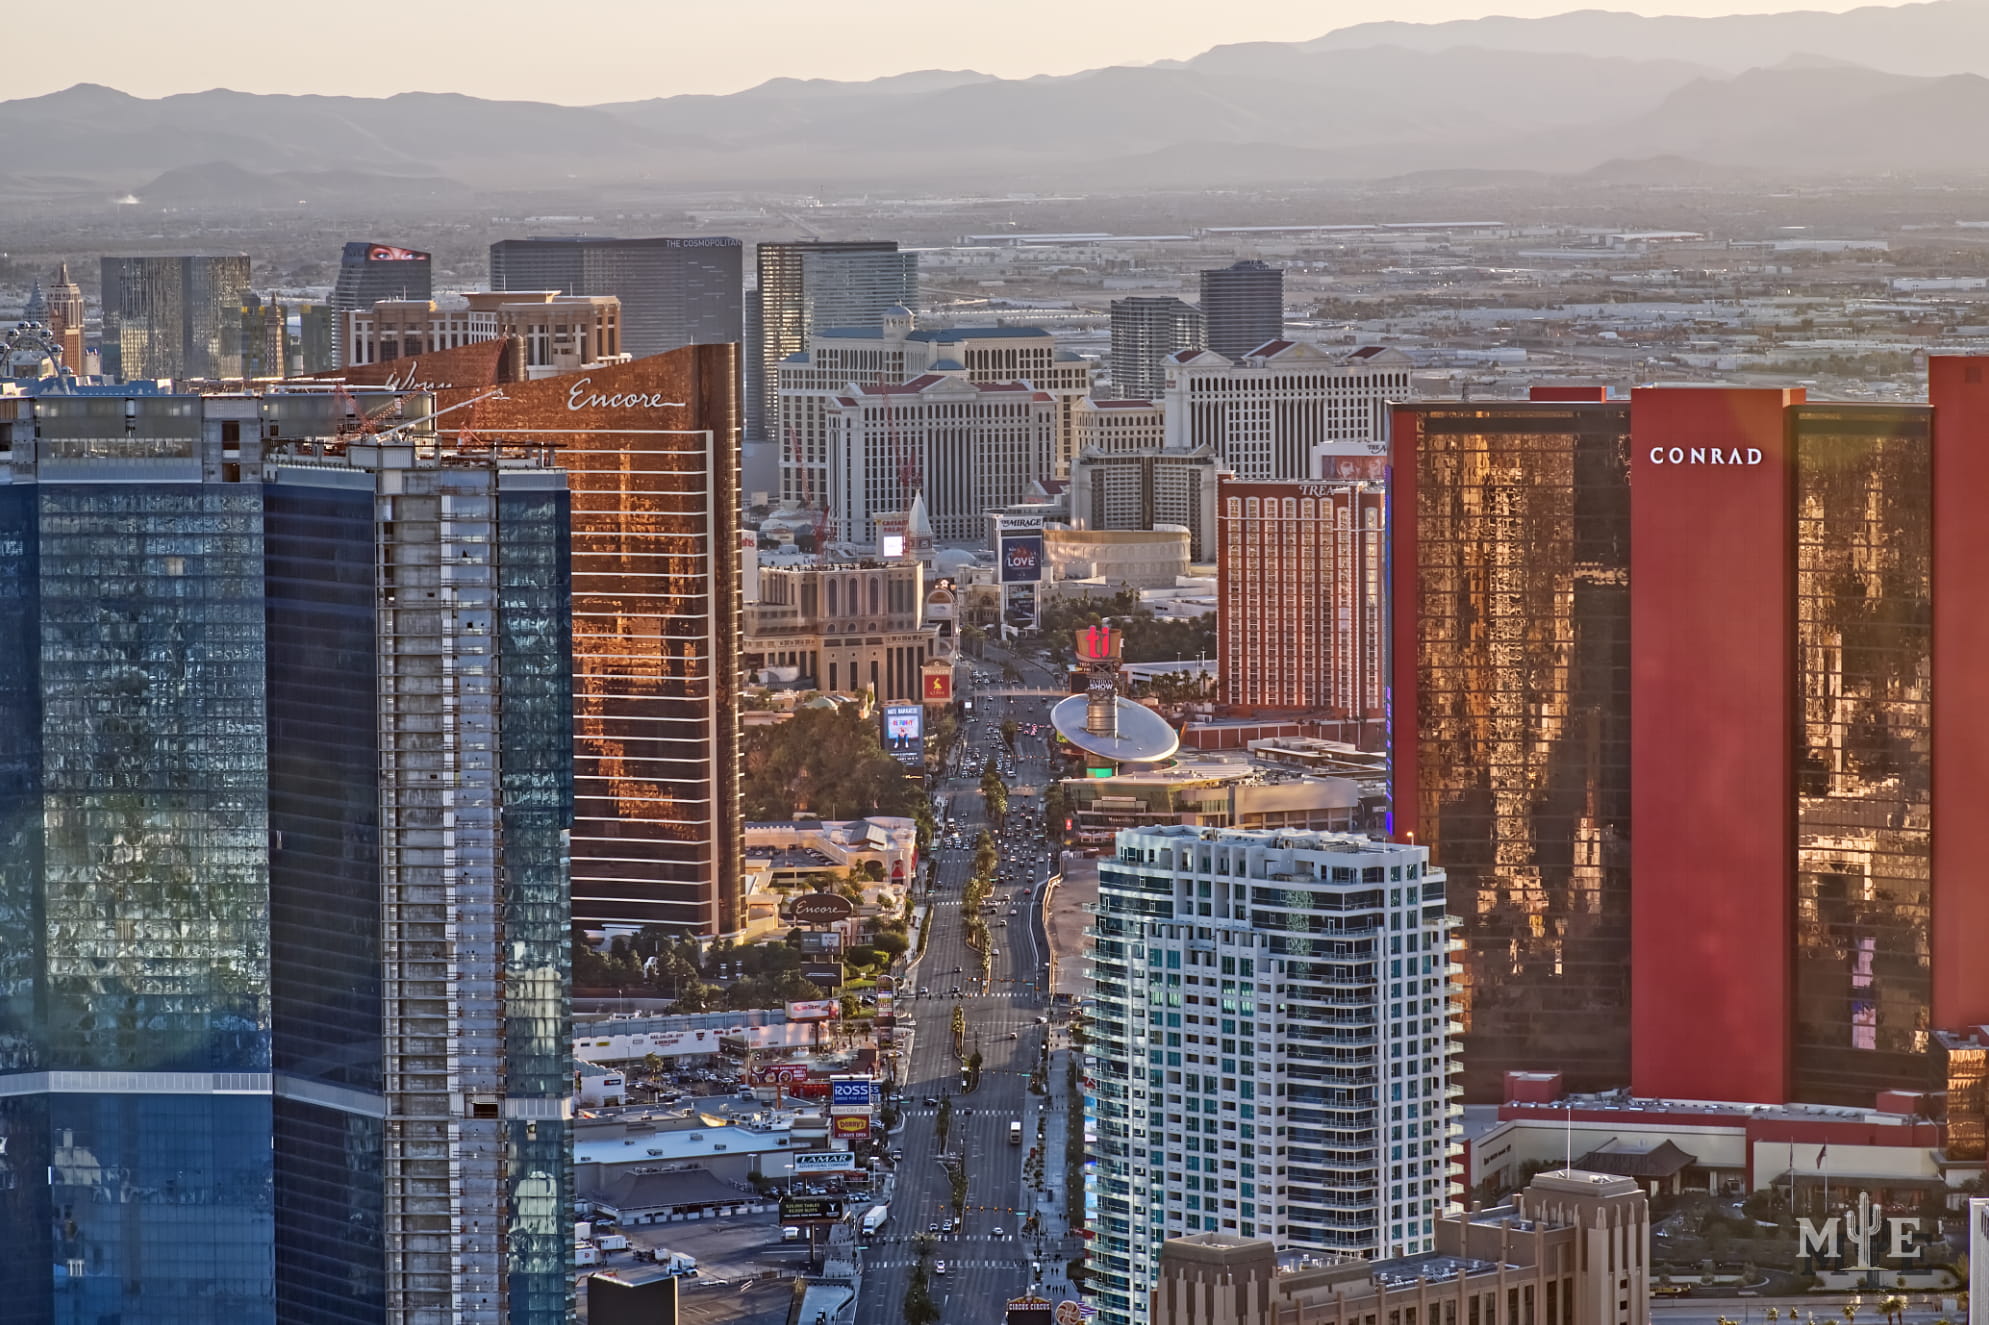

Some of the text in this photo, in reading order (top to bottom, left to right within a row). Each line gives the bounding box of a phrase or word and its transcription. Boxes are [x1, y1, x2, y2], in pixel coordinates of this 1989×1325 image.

[665, 239, 741, 248] THE COSMOPOLITAN
[567, 377, 686, 411] Encore
[1650, 447, 1762, 464] CONRAD
[1299, 485, 1349, 497] TREA
[1010, 518, 1041, 528] MIRAGE
[1007, 556, 1036, 567] LOVE
[1085, 624, 1110, 658] ti
[795, 900, 849, 914] Encore
[834, 1085, 869, 1096] ROSS
[800, 1155, 848, 1163] LAMAR
[1008, 1303, 1050, 1311] CIRCUS CIRCUS
